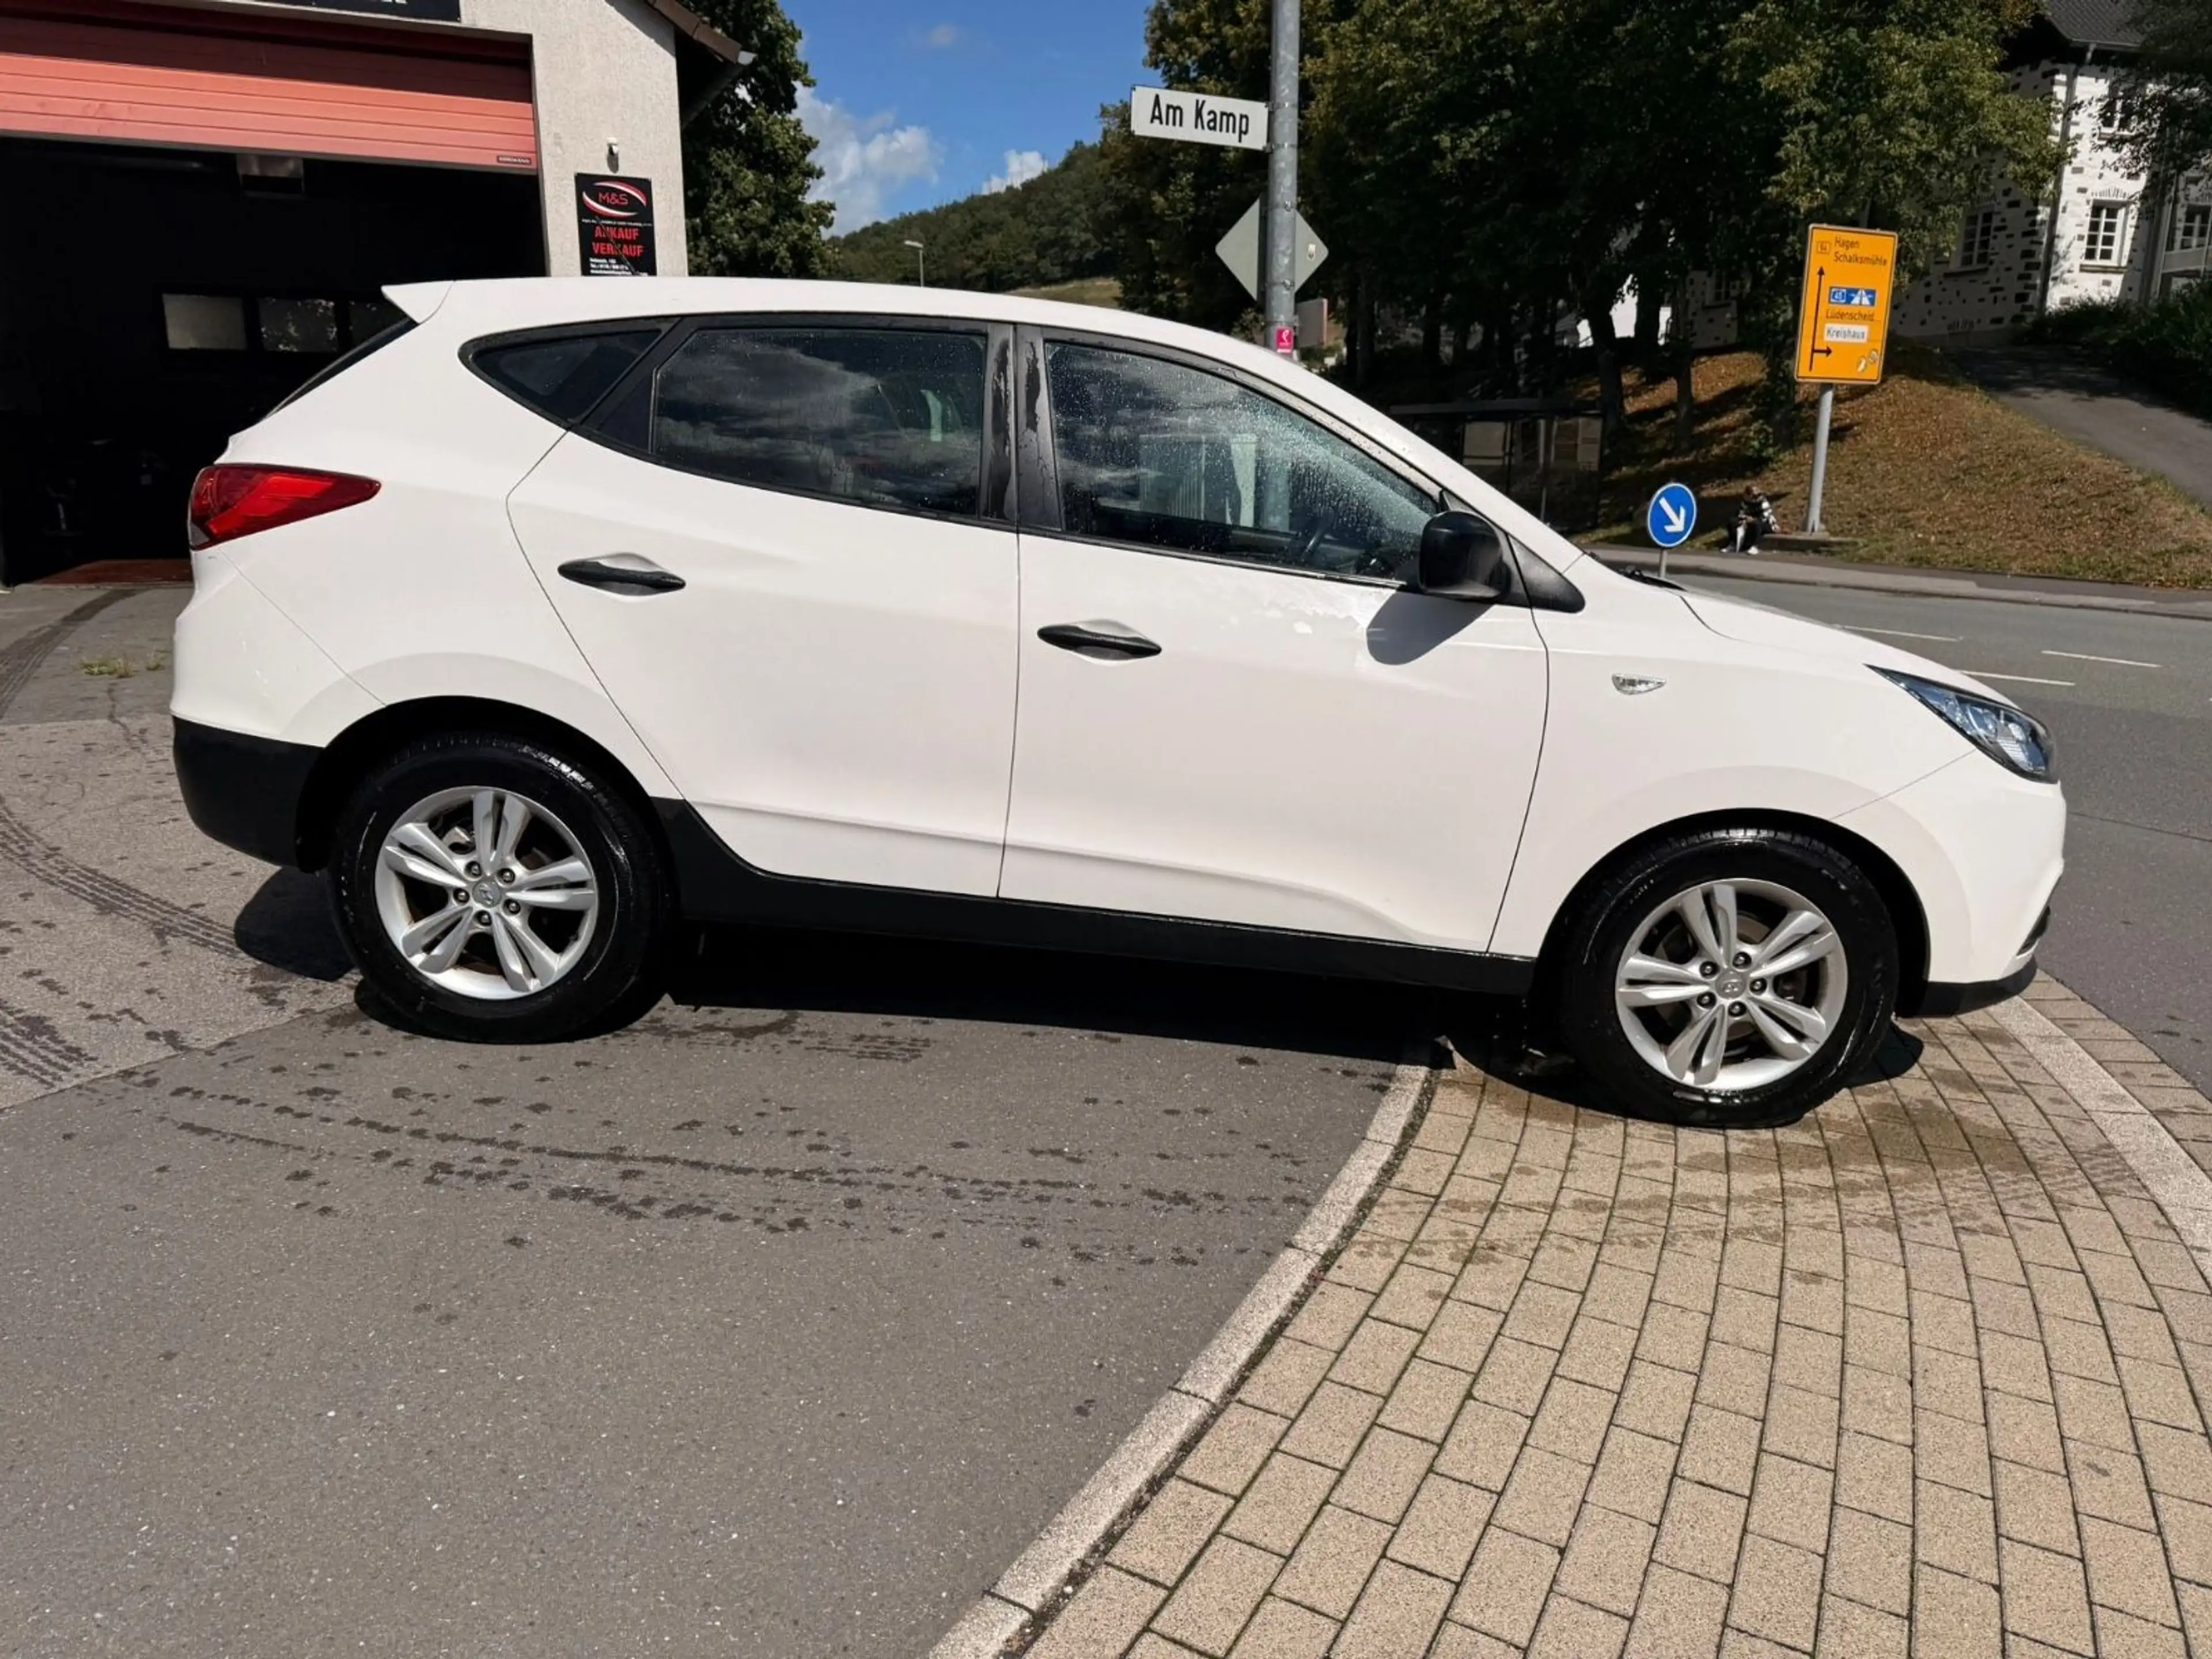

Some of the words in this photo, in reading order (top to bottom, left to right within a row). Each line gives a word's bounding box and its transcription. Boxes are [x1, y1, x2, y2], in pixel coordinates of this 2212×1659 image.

[1150, 93, 1183, 127] Am
[1194, 99, 1249, 143] Kamp
[598, 192, 629, 206] M&S
[592, 242, 643, 257] VERAUF
[1834, 235, 1860, 251] Hagen
[1834, 251, 1888, 266] Schalksmühle
[1826, 327, 1865, 339] Kreishaus
